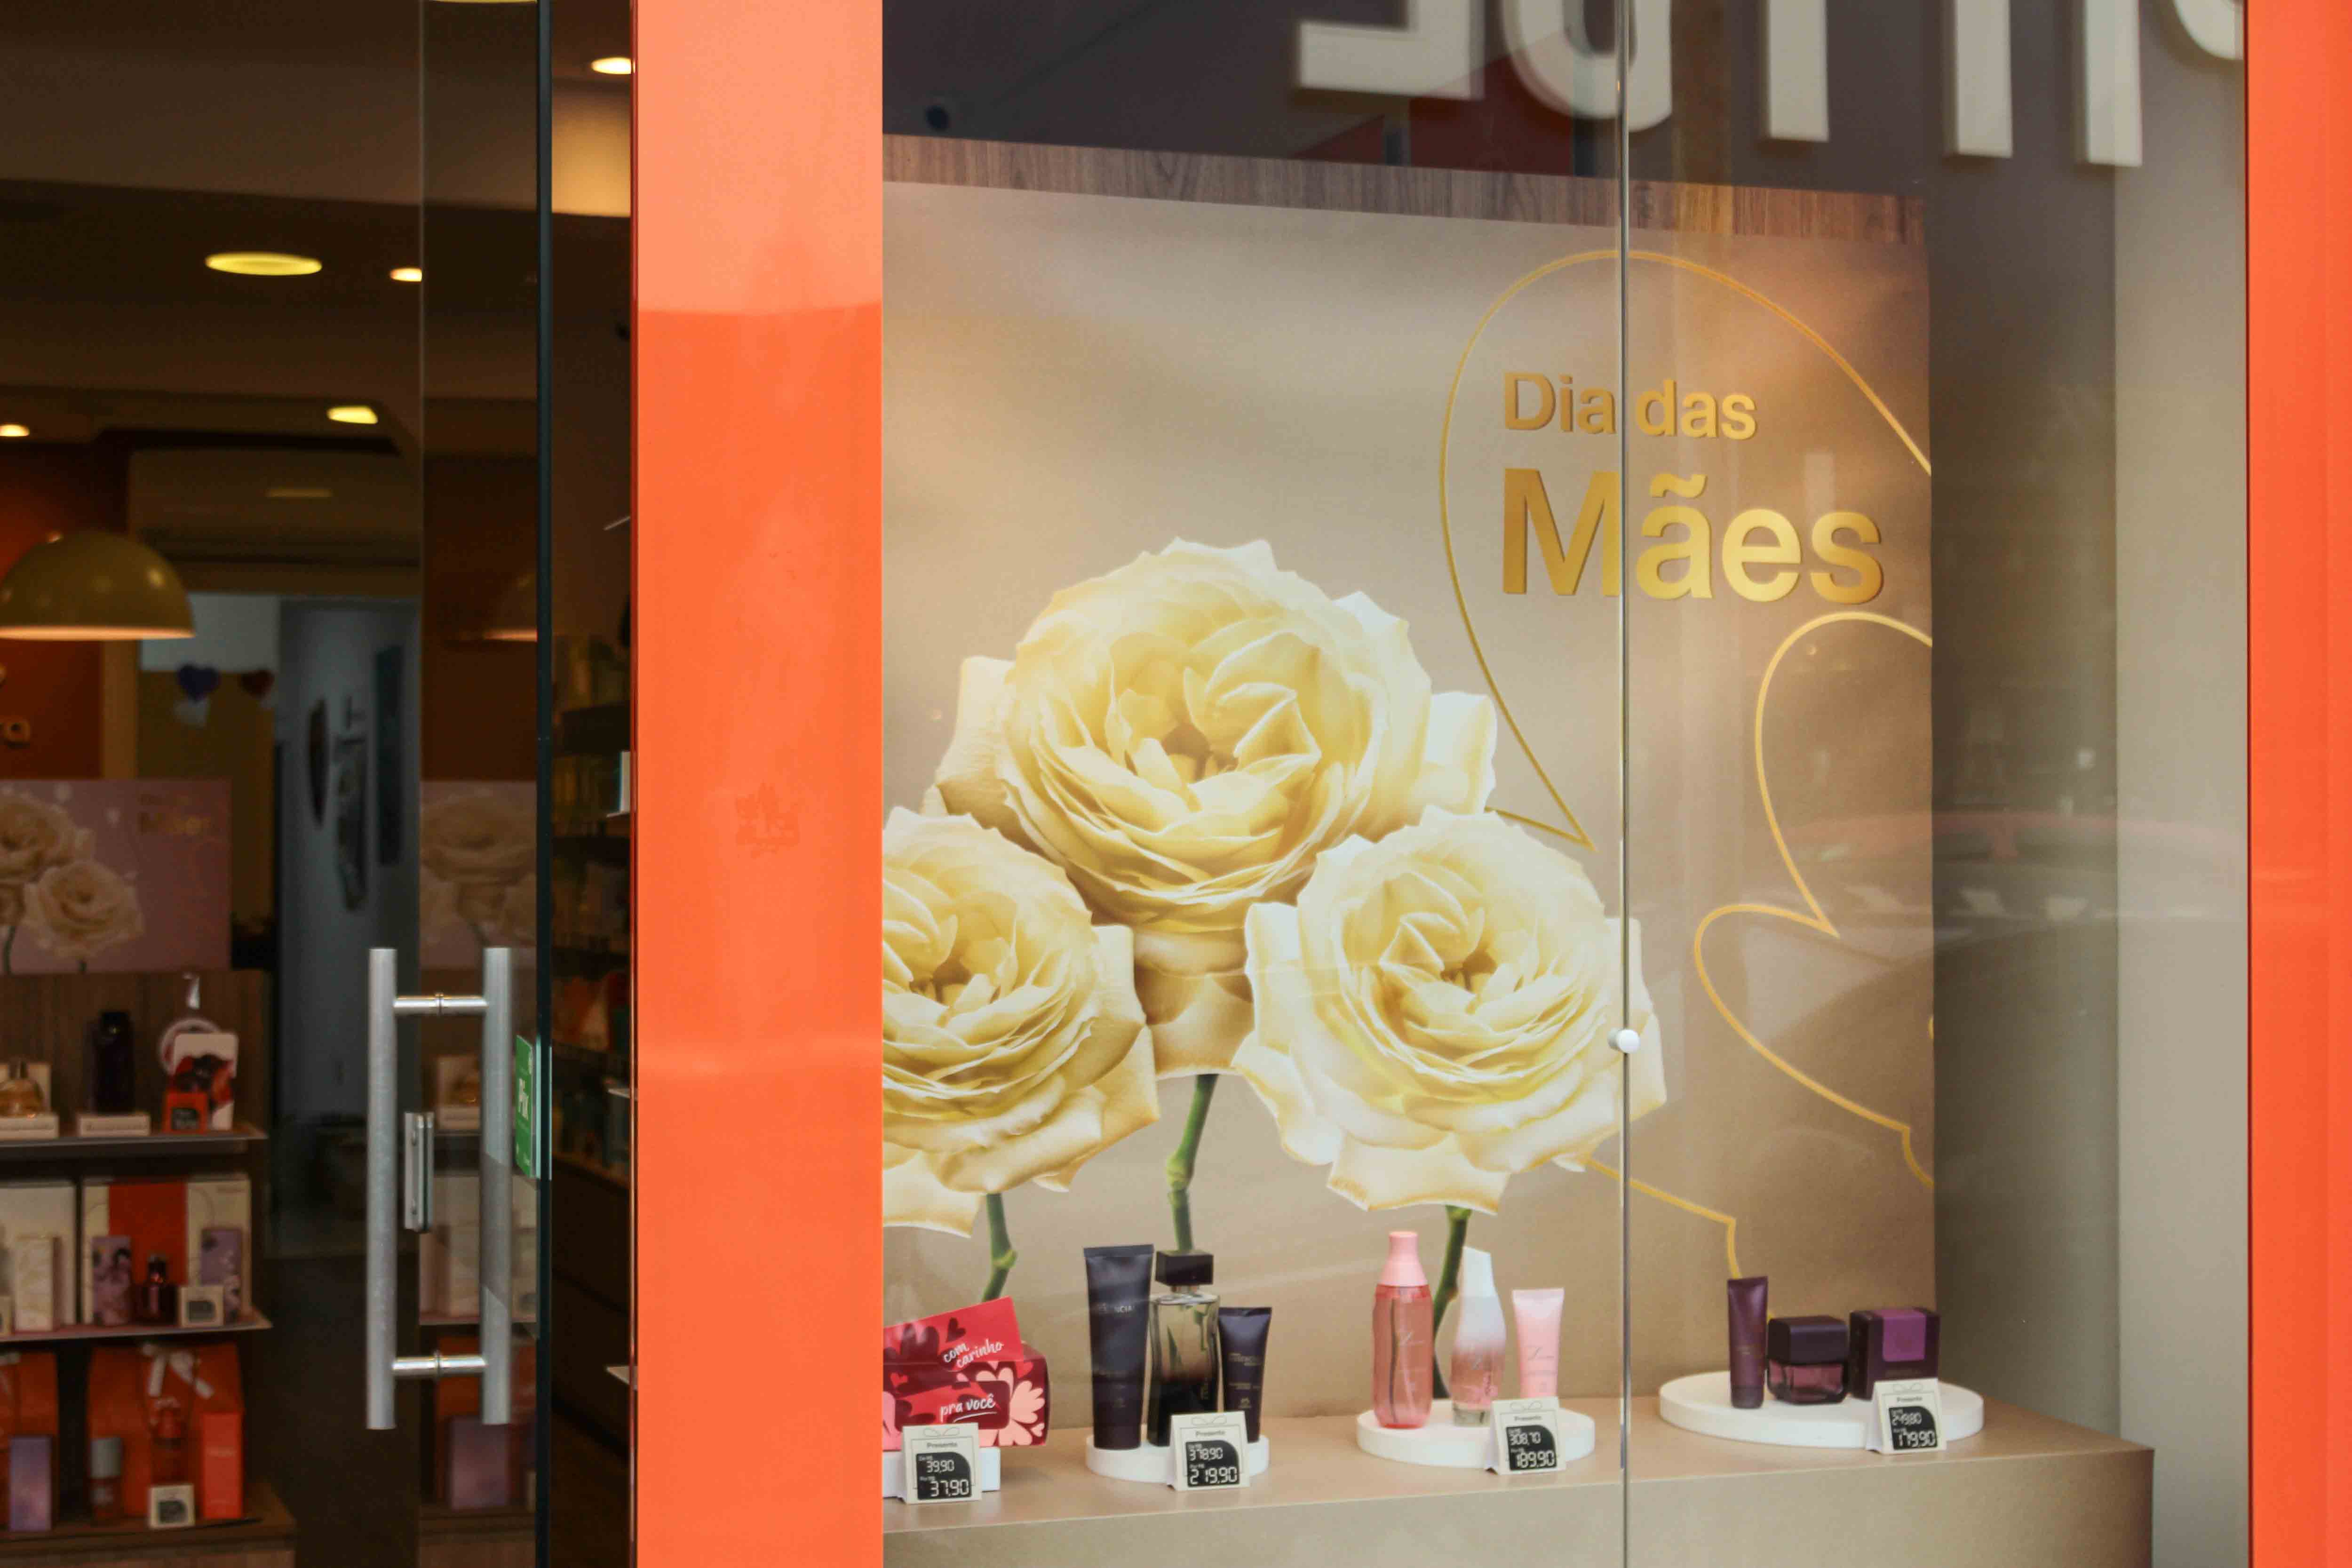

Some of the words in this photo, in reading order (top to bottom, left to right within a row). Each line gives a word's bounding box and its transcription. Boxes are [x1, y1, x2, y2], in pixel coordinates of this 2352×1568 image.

[1504, 371, 1617, 434] Dia
[1636, 378, 1757, 440] das
[1502, 468, 1884, 606] Mães
[943, 1343, 969, 1363] com
[955, 1338, 1004, 1368] carinho
[939, 1402, 963, 1424] pra
[967, 1393, 996, 1411] você
[927, 1459, 955, 1473] 39,90
[1516, 1450, 1555, 1468] 189,90
[1190, 1466, 1238, 1485] 219,90
[930, 1479, 969, 1497] 37,90
